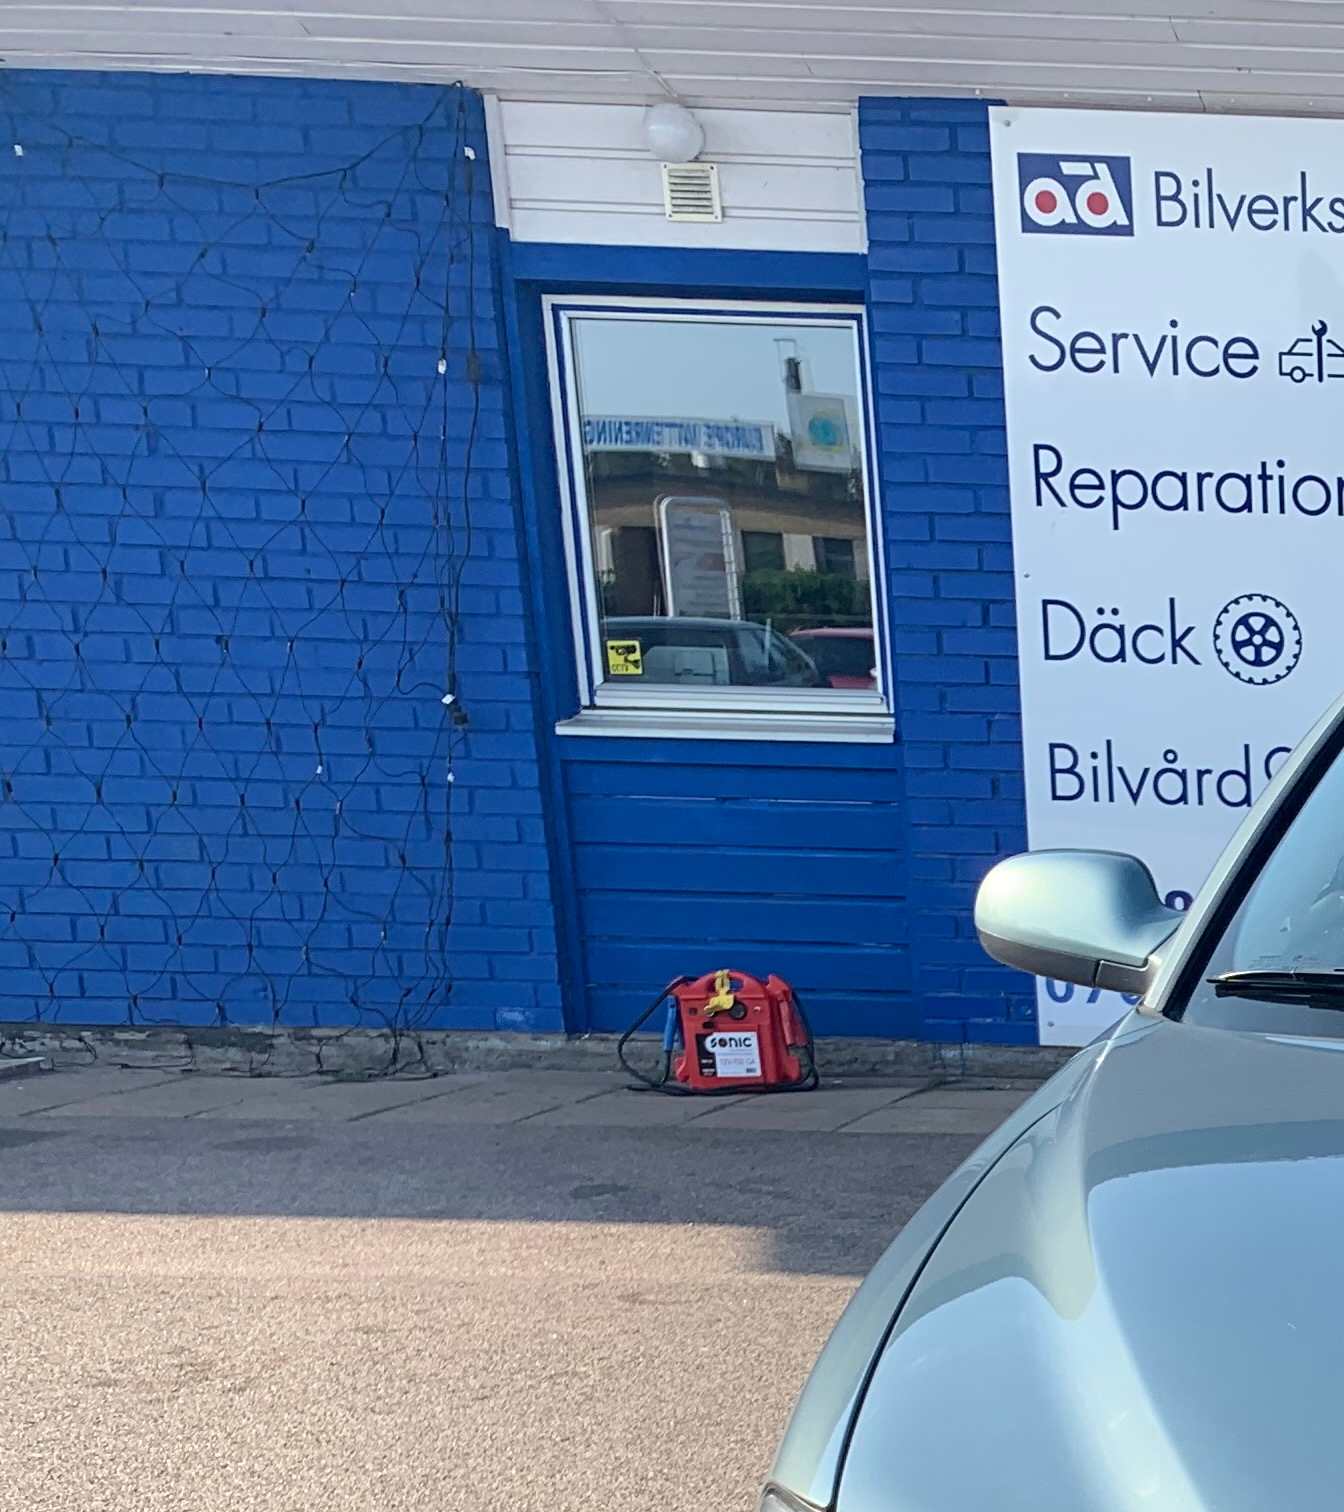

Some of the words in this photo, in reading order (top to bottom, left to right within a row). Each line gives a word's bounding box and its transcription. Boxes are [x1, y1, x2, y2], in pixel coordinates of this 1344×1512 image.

[1028, 305, 1260, 378] Service
[1040, 597, 1202, 666] Däck
[1047, 738, 1253, 808] Bilvård
